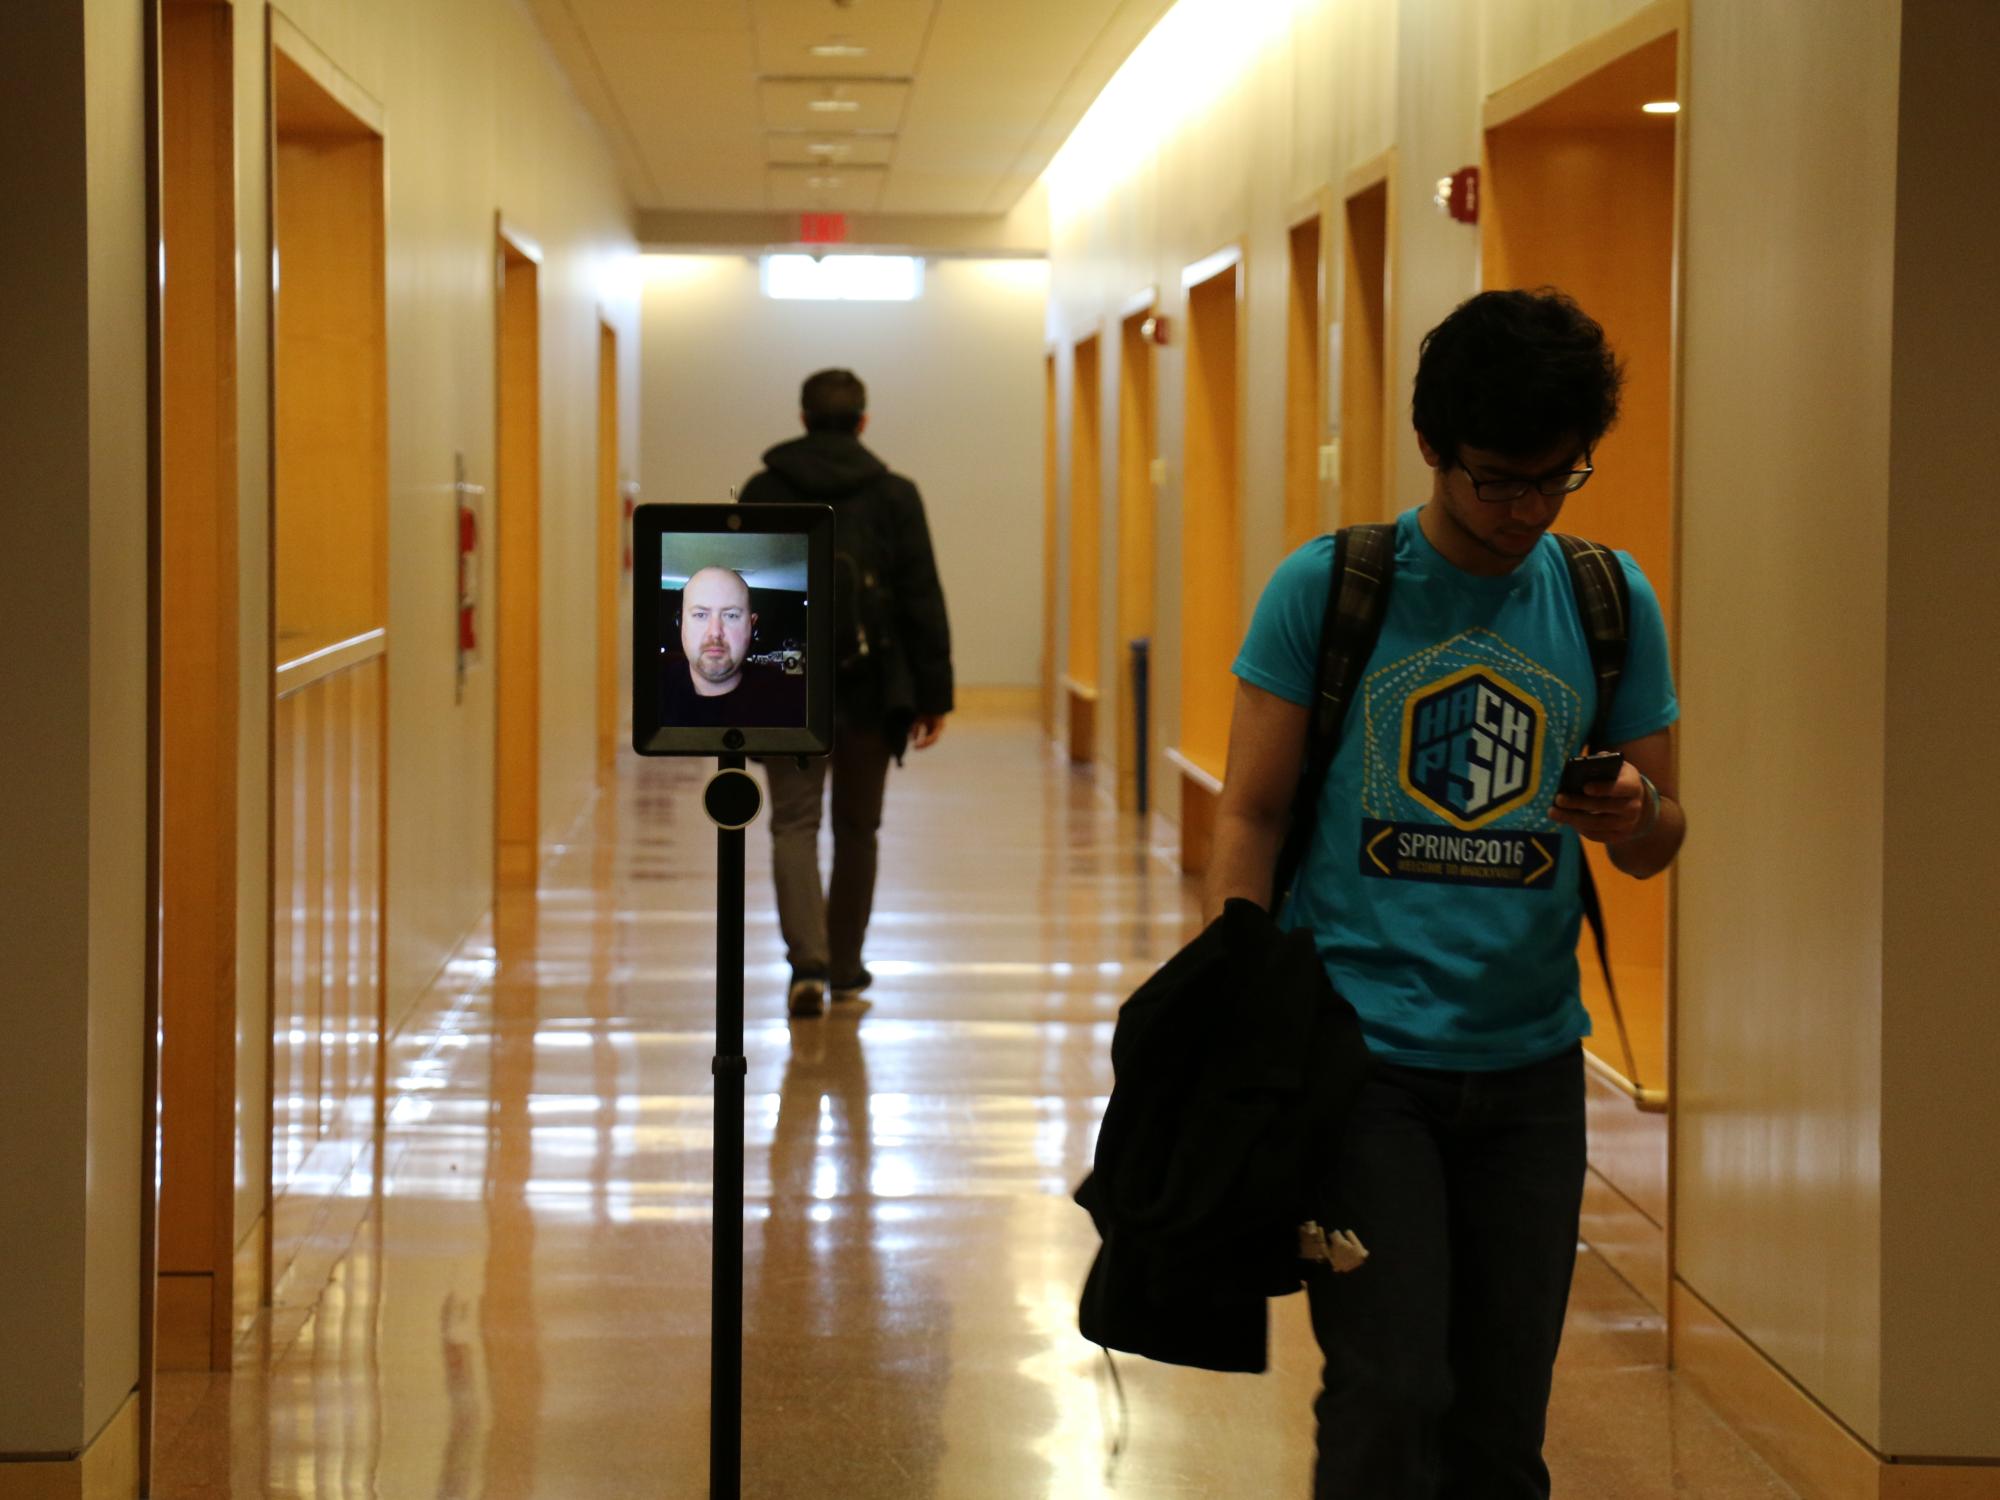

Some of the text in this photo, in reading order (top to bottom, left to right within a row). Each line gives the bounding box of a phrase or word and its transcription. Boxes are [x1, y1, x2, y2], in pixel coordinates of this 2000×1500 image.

[1417, 682, 1531, 754] HACK
[1413, 727, 1526, 814] PSU
[1398, 832, 1526, 865] SPRING2016
